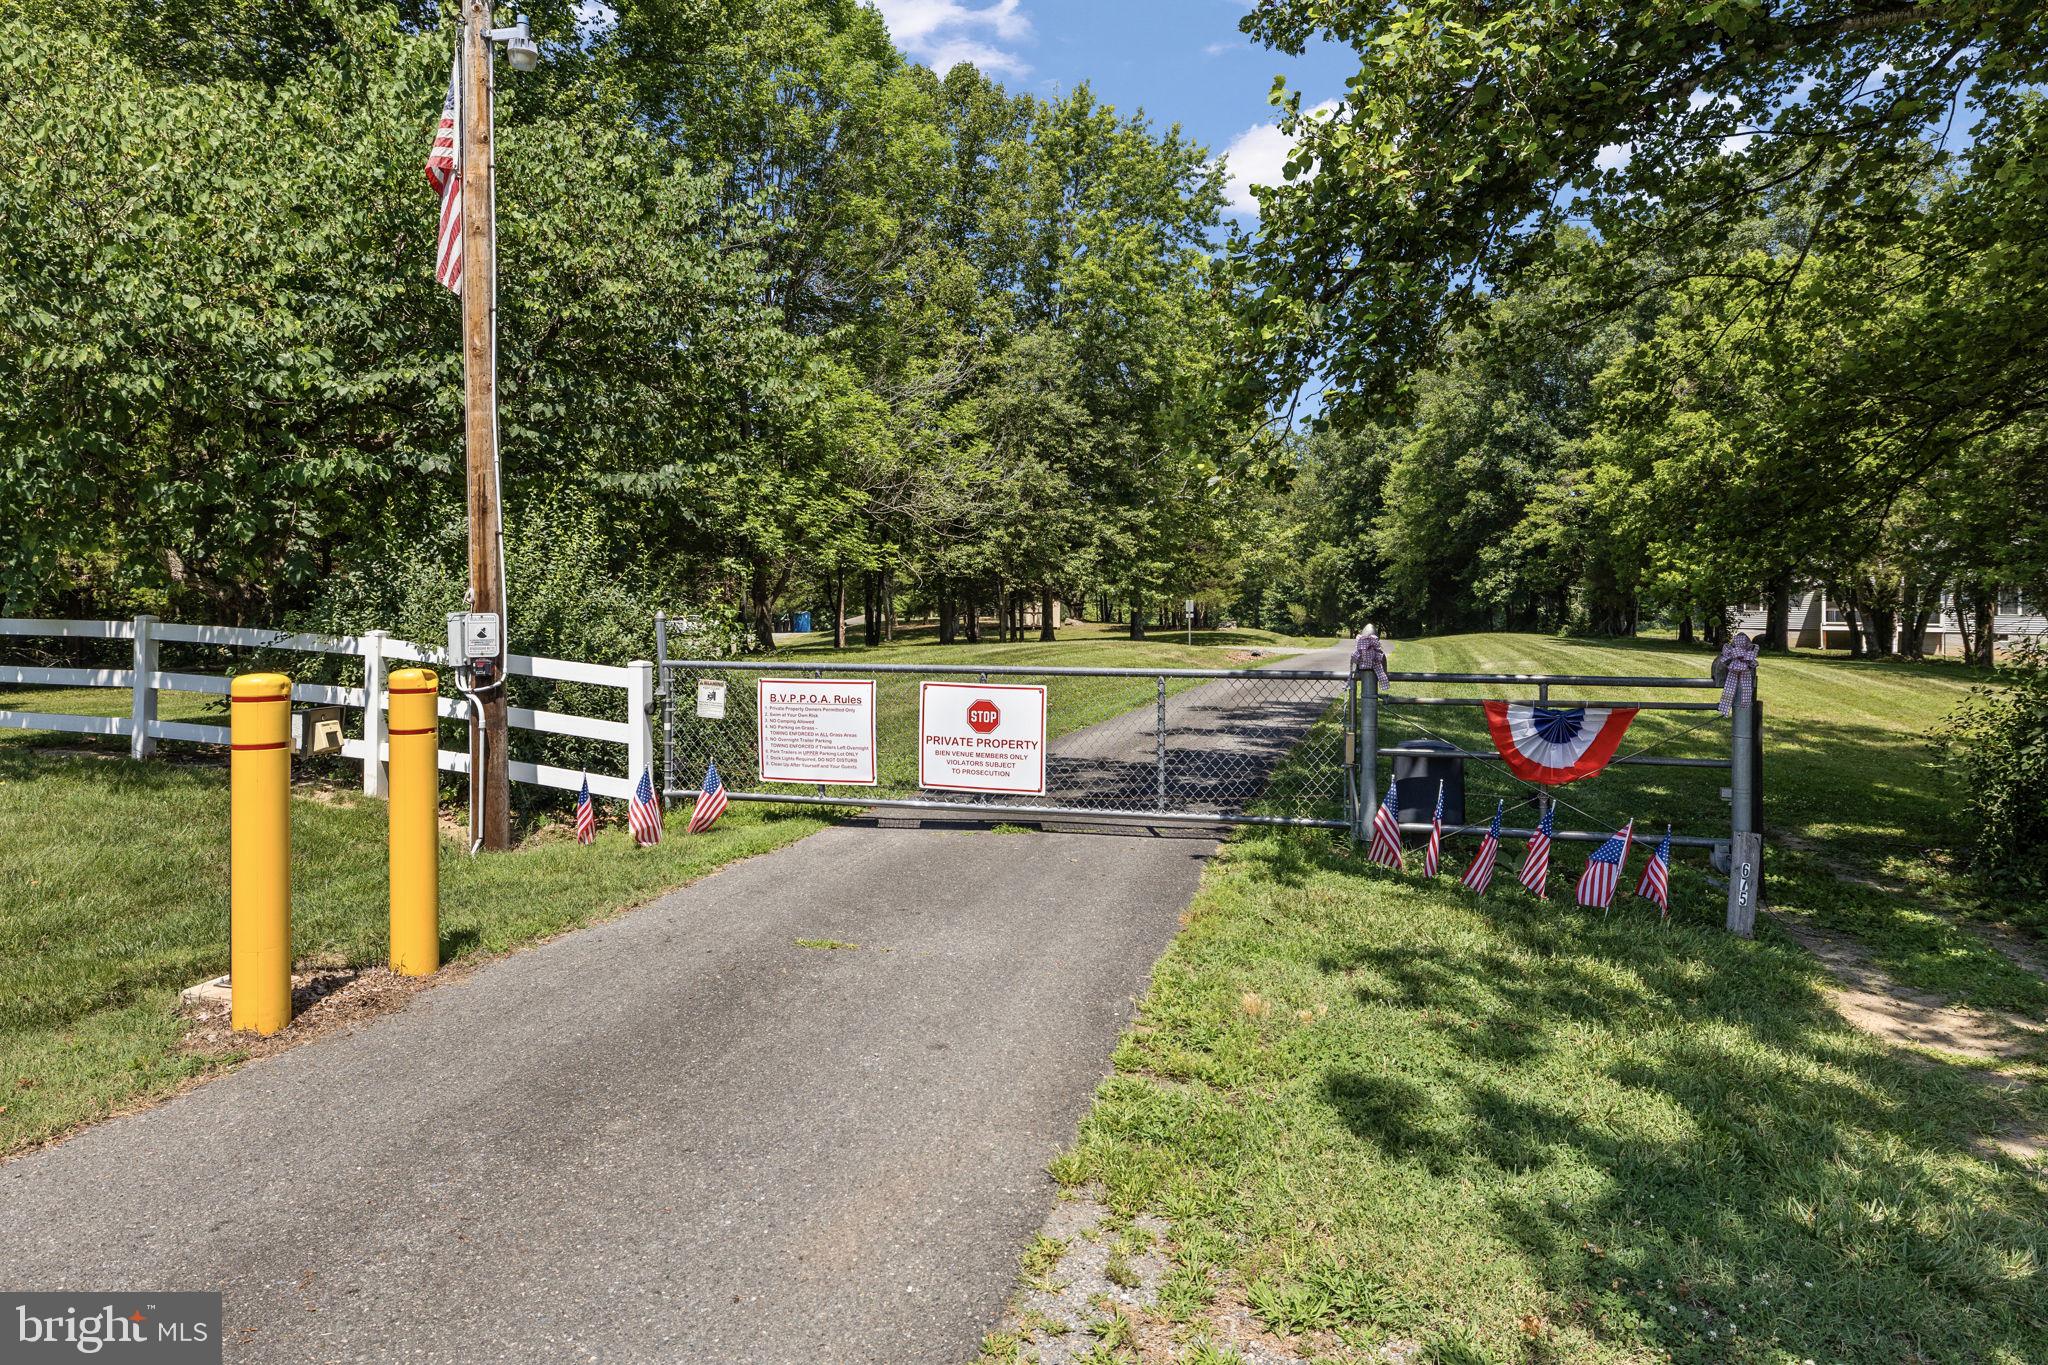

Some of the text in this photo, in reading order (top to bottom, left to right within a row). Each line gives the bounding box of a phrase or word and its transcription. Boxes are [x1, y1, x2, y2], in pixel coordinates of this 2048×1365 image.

[770, 694, 862, 704] B.V.P.P.O.A. Rules
[971, 710, 996, 722] STOP
[926, 736, 1038, 750] PRIVATE PROPERTY
[1739, 863, 1750, 906] 675
